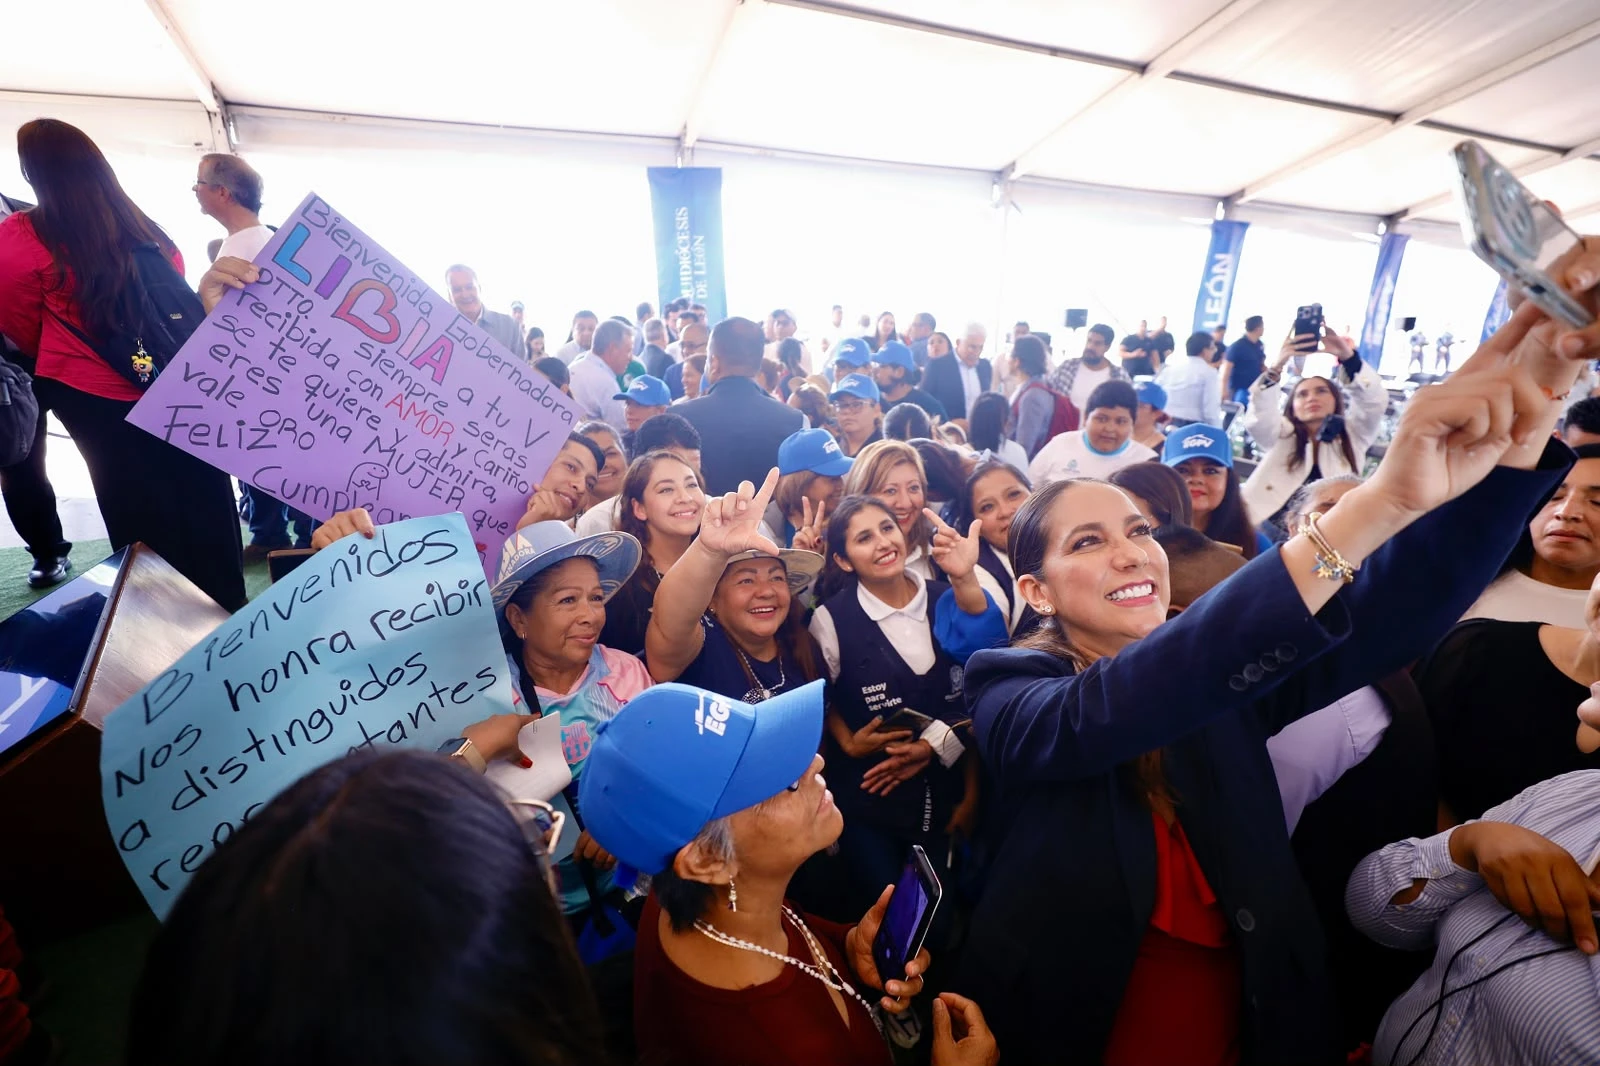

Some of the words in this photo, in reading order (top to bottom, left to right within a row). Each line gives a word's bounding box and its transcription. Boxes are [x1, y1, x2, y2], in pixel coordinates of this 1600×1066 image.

[301, 197, 435, 317] Bienvenida
[445, 315, 573, 425] Gobernadora
[692, 235, 707, 276] LEÓN
[695, 279, 708, 299] DE
[1202, 253, 1233, 329] LEÓN
[182, 362, 245, 408] vale
[259, 410, 315, 450] ORO
[213, 314, 256, 348] se
[269, 337, 297, 372] te
[304, 374, 381, 432] quiere
[414, 448, 498, 504] admira,
[236, 291, 340, 370] recibida
[347, 370, 383, 401] con
[385, 394, 455, 446] AMOR
[451, 443, 467, 459] y
[474, 449, 529, 494] Cariño
[273, 222, 454, 386] LIBIA
[458, 388, 474, 405] a
[484, 395, 511, 428] tu
[524, 418, 549, 449] V
[354, 342, 449, 416] siempre
[463, 423, 527, 469] seras
[209, 342, 282, 395] eres
[307, 401, 352, 443] una
[363, 436, 466, 511] MUJER
[472, 509, 509, 535] que
[115, 723, 202, 797] Nos
[223, 628, 356, 711] honra
[370, 579, 486, 639] recibir
[143, 529, 459, 724] Bienvenidos
[861, 682, 887, 695] Estoy
[865, 692, 886, 704] para
[868, 696, 903, 712] servirte
[119, 819, 151, 851] a
[172, 652, 427, 810] distinguidos
